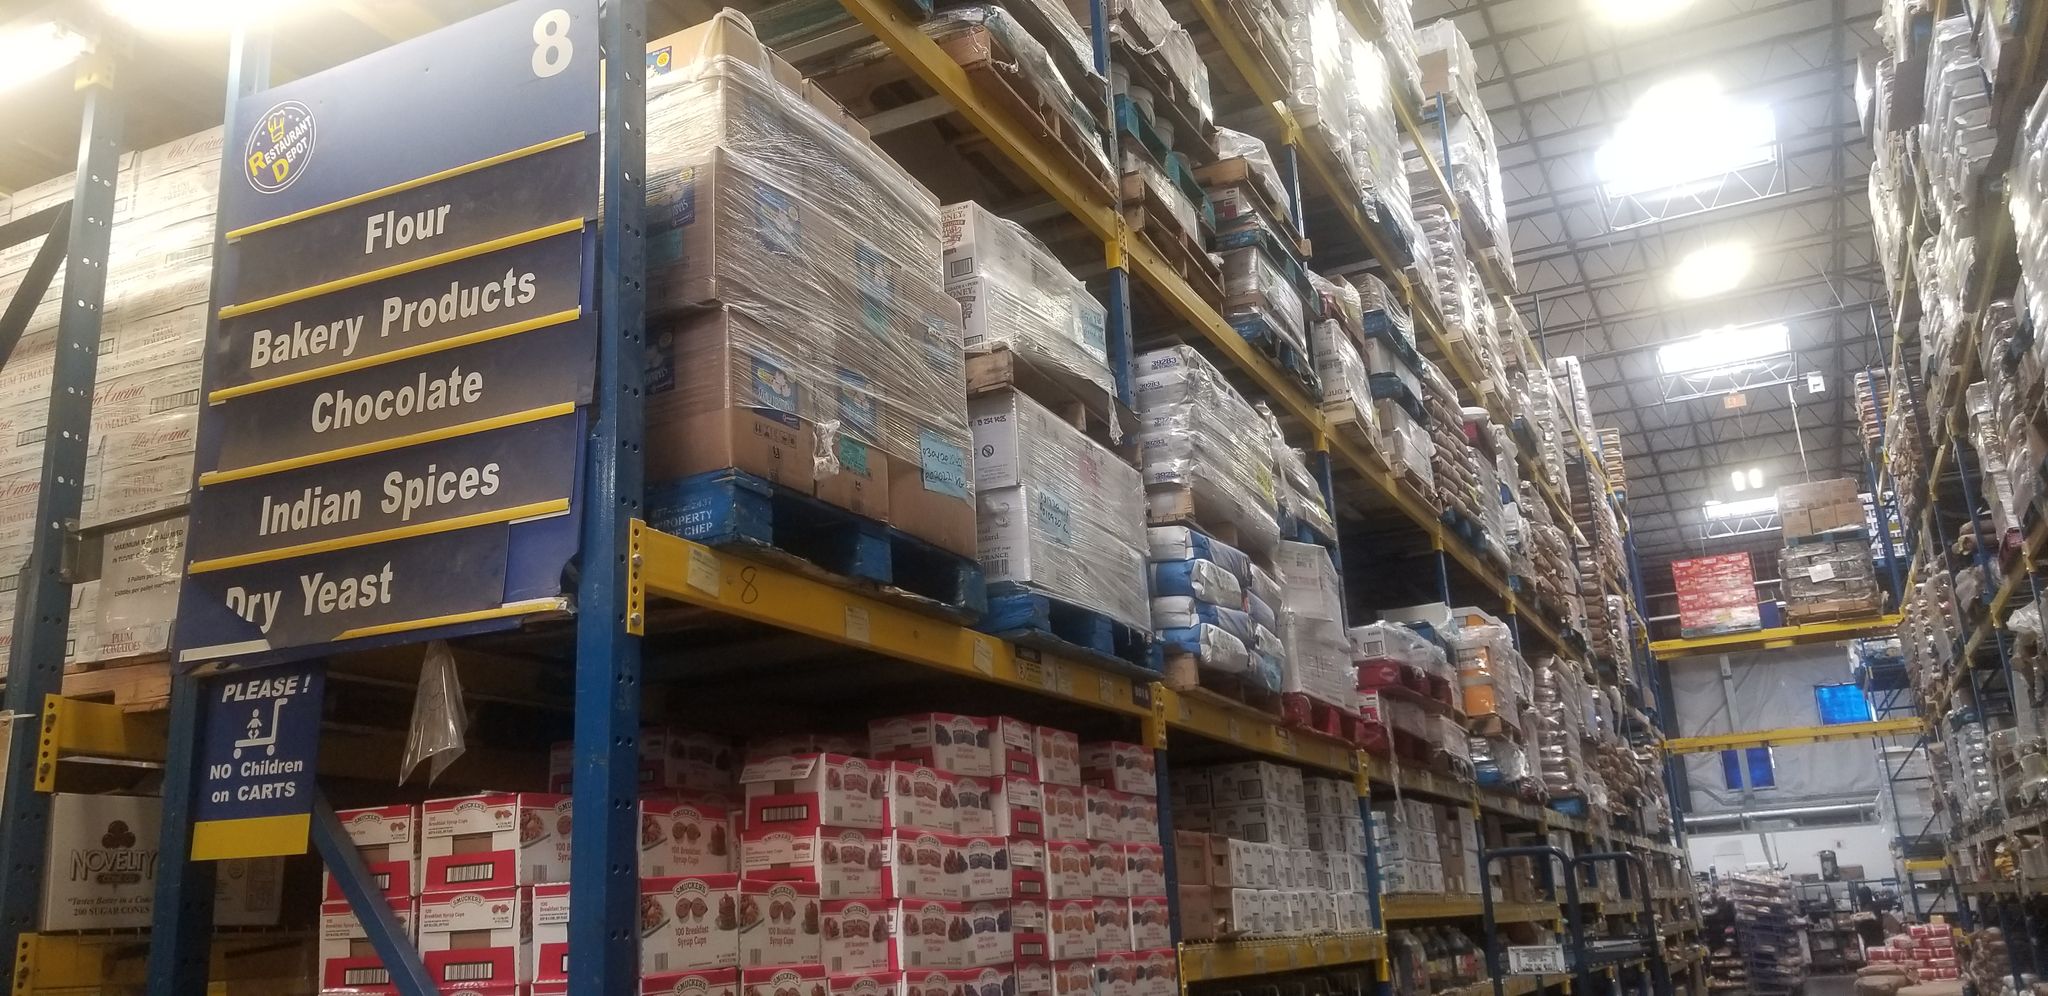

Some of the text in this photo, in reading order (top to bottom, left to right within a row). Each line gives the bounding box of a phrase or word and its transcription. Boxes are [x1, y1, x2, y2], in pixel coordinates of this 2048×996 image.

[531, 8, 575, 79] 8
[248, 115, 312, 177] RESTAURANT
[271, 136, 308, 183] DEPOT
[364, 203, 452, 255] Flour
[249, 267, 538, 370] Bakery Products
[1151, 357, 1177, 368] 39283
[311, 365, 485, 435] Chocolate
[1327, 388, 1343, 397] JUG
[259, 461, 501, 536] Indian Spices
[655, 509, 713, 528] PROPERTY
[684, 521, 713, 536] CHEP
[225, 560, 395, 634] Dry Yeast
[740, 566, 759, 605] 8
[221, 673, 312, 703] PLEASE !
[209, 758, 304, 780] NO Children
[211, 781, 296, 803] on CARTS
[69, 849, 160, 881] NOVELTY
[120, 906, 151, 915] CONES
[677, 936, 707, 948] Syrup Cups
